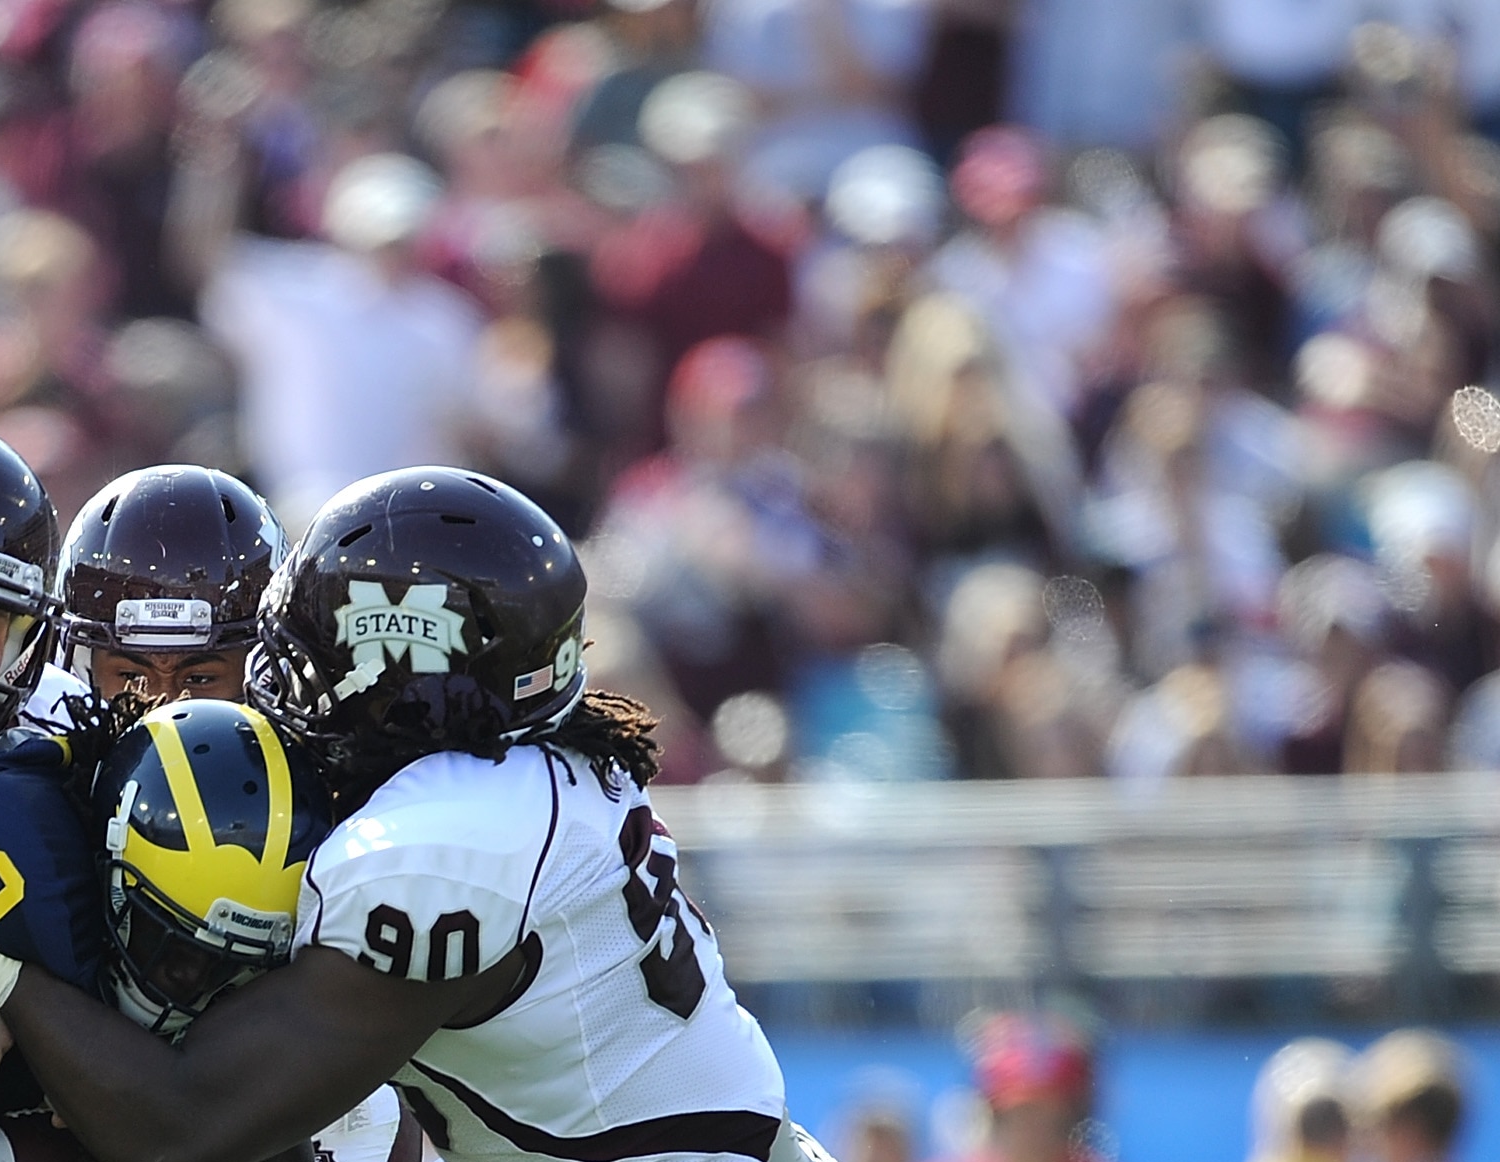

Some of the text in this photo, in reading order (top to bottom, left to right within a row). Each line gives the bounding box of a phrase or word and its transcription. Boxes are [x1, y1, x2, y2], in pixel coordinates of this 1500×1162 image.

[355, 613, 438, 641] STATE
[230, 911, 275, 931] MICHIGAN
[356, 903, 480, 982] 90
